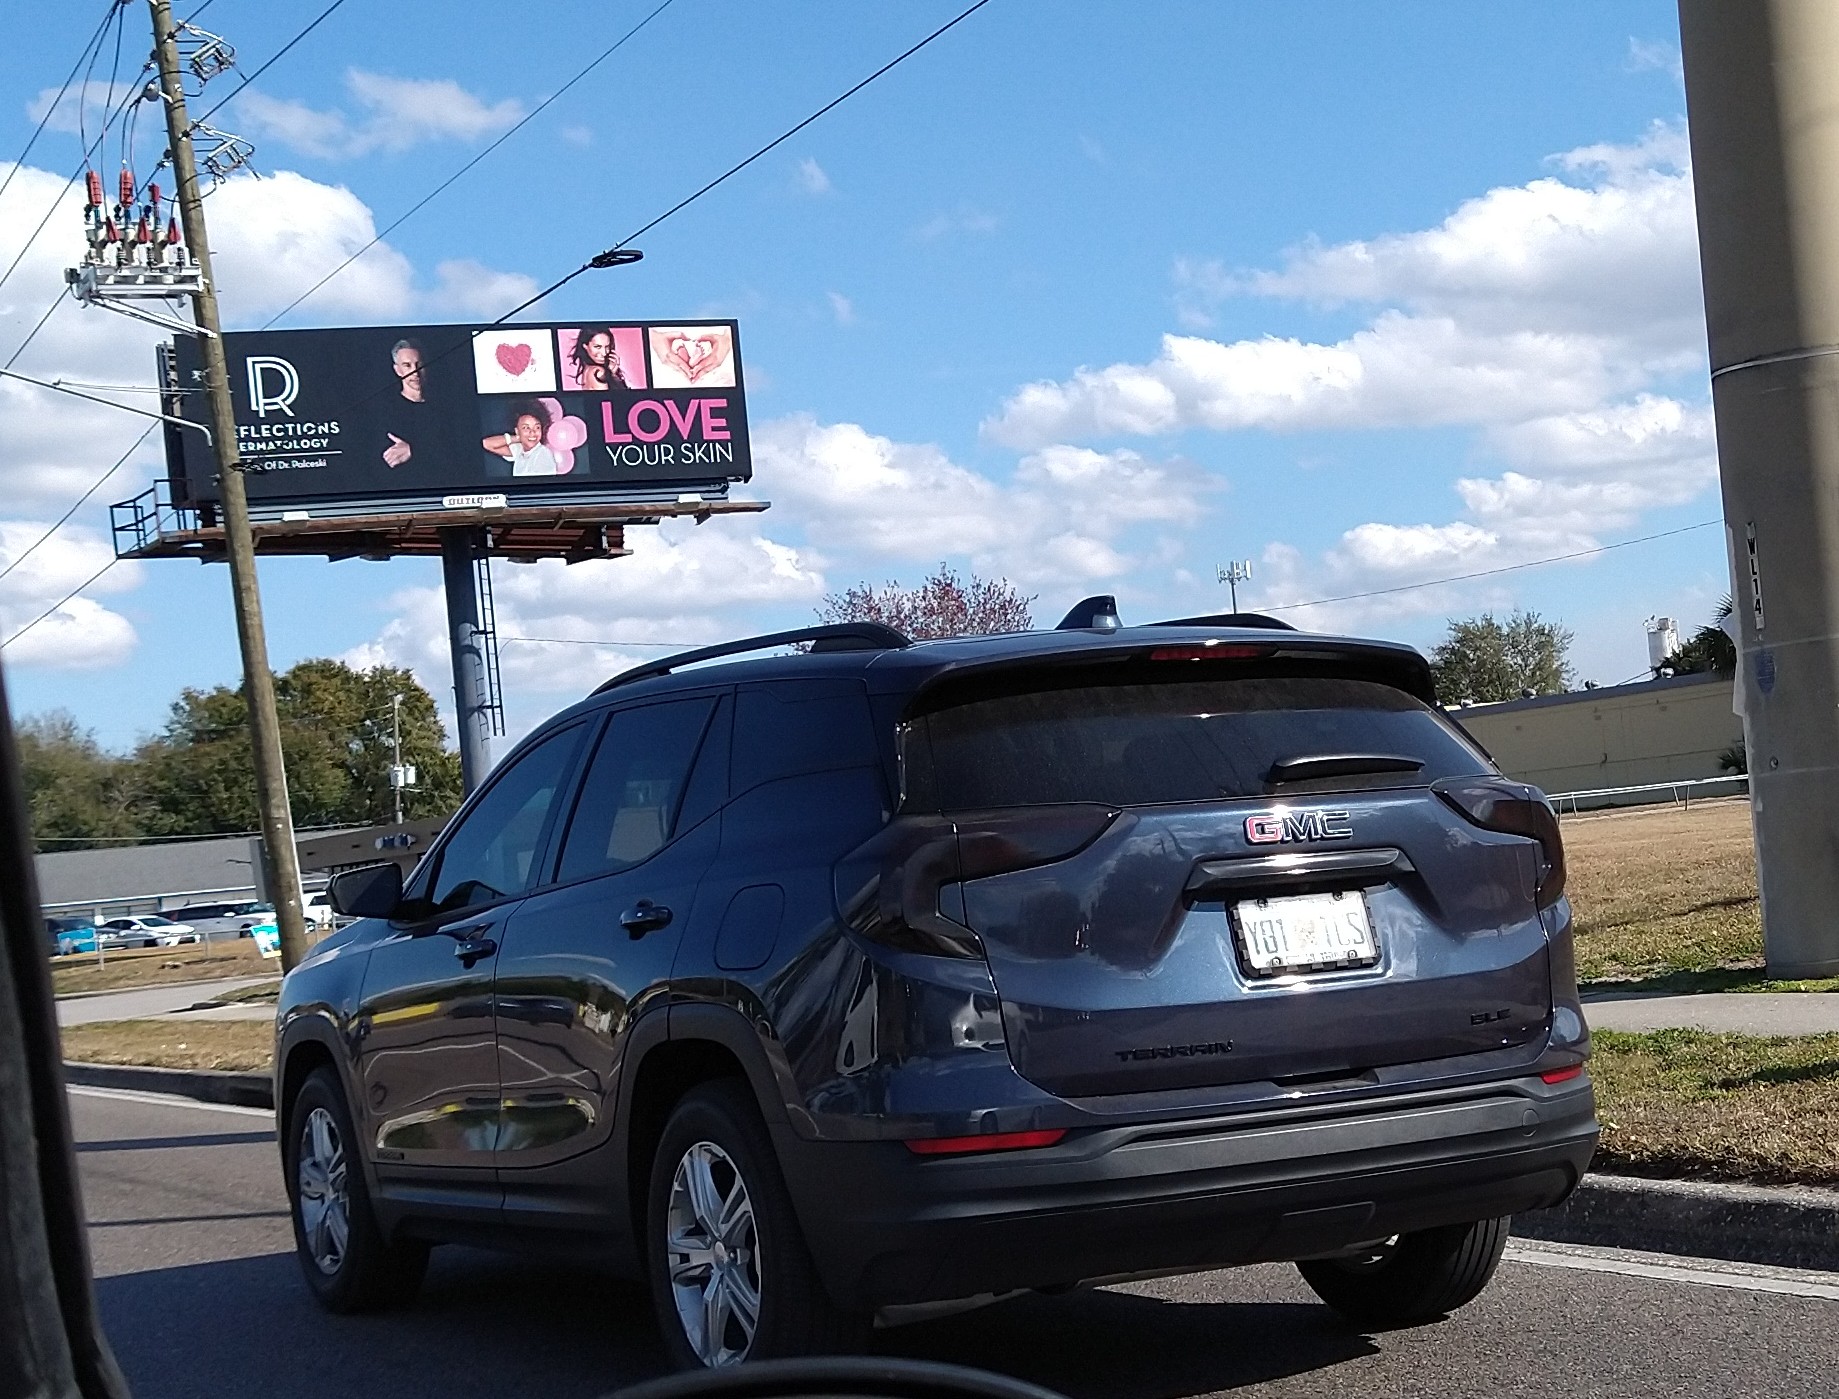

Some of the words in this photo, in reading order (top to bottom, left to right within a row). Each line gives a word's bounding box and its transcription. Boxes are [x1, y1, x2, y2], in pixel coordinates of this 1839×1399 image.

[234, 421, 340, 438] FLECTIONS
[601, 398, 731, 444] LOVE
[239, 438, 329, 452] ERMATOLOGY
[605, 444, 675, 467] YOUR
[681, 442, 733, 465] SKIN
[1245, 810, 1354, 844] GMC
[1115, 1039, 1234, 1062] TERRAIN
